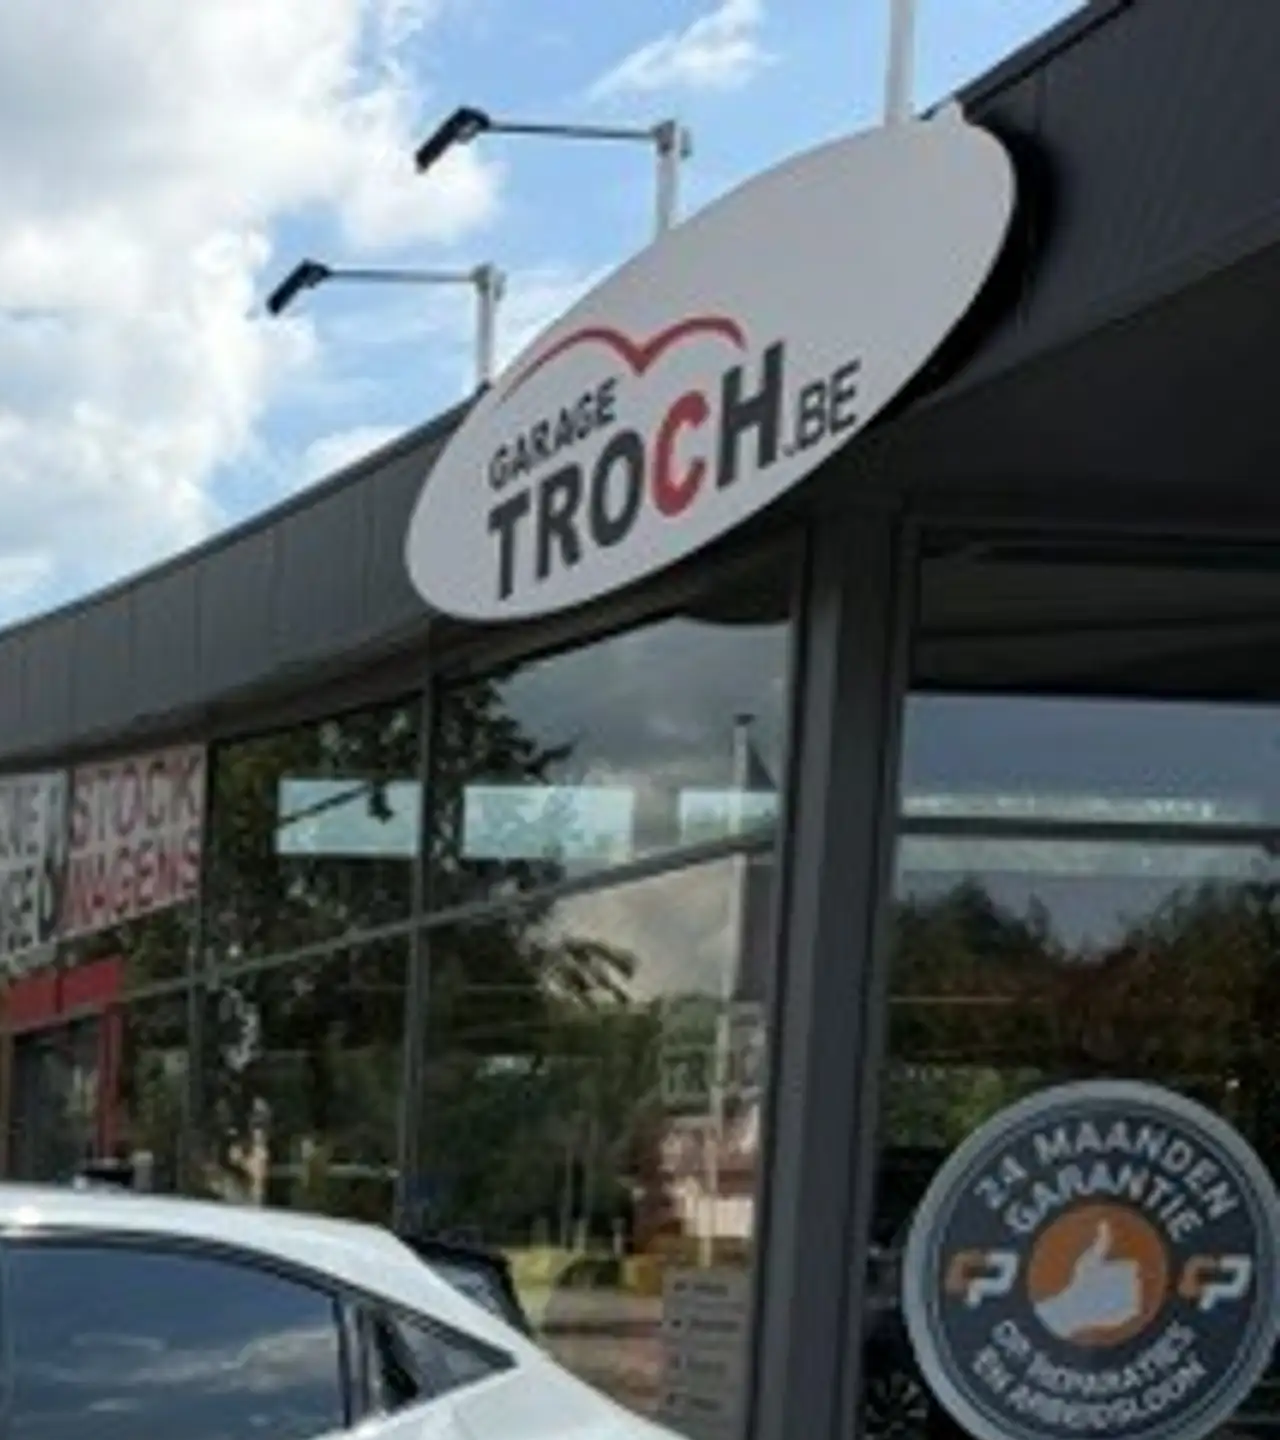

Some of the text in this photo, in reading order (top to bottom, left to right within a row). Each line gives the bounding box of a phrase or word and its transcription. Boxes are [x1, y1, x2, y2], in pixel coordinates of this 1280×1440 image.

[487, 377, 618, 491] GARAGE
[1004, 1163, 1205, 1243] GARANTIE
[1033, 1120, 1240, 1221] MAANDEN
